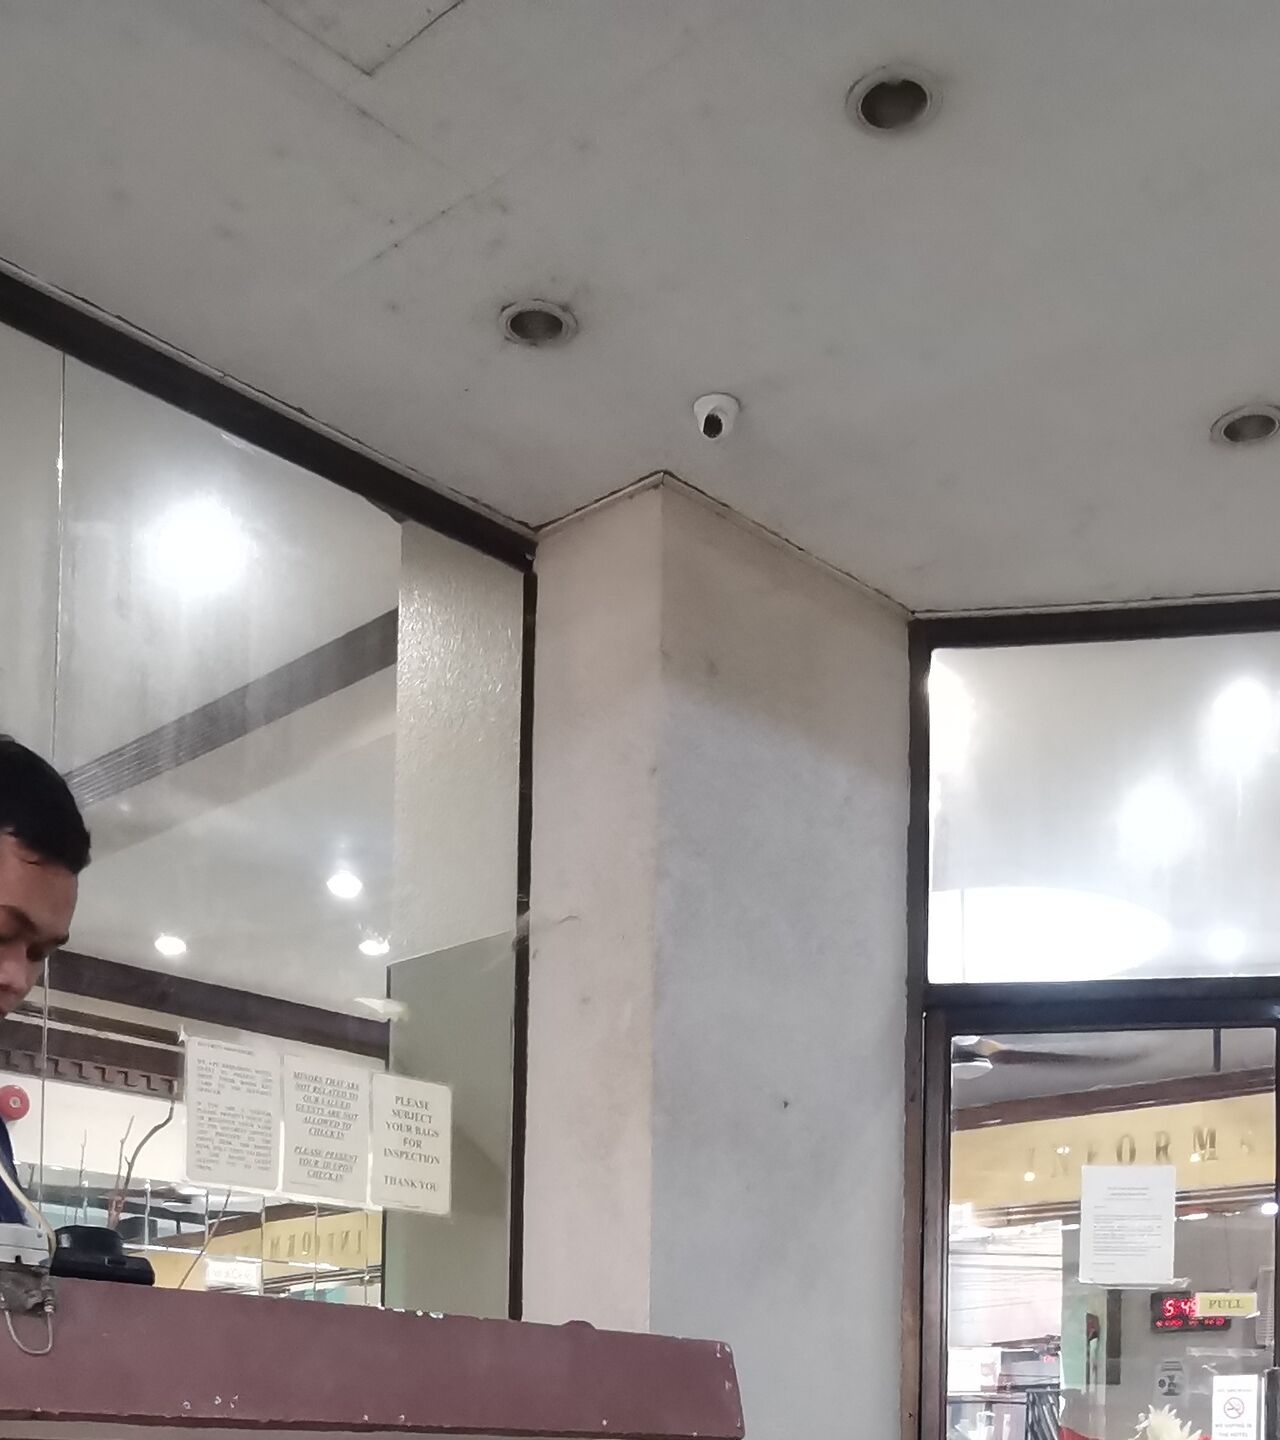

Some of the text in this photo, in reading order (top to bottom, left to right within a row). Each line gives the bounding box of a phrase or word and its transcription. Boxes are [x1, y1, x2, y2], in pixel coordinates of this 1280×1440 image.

[395, 1095, 429, 1111] PLEASE
[391, 1108, 433, 1124] SUBJECT
[385, 1121, 440, 1138] YOUR BAGS
[402, 1137, 423, 1149] FOR
[383, 1147, 440, 1165] INSPECTION
[384, 1174, 438, 1193] THANK YOU
[1208, 1298, 1245, 1310] PULL
